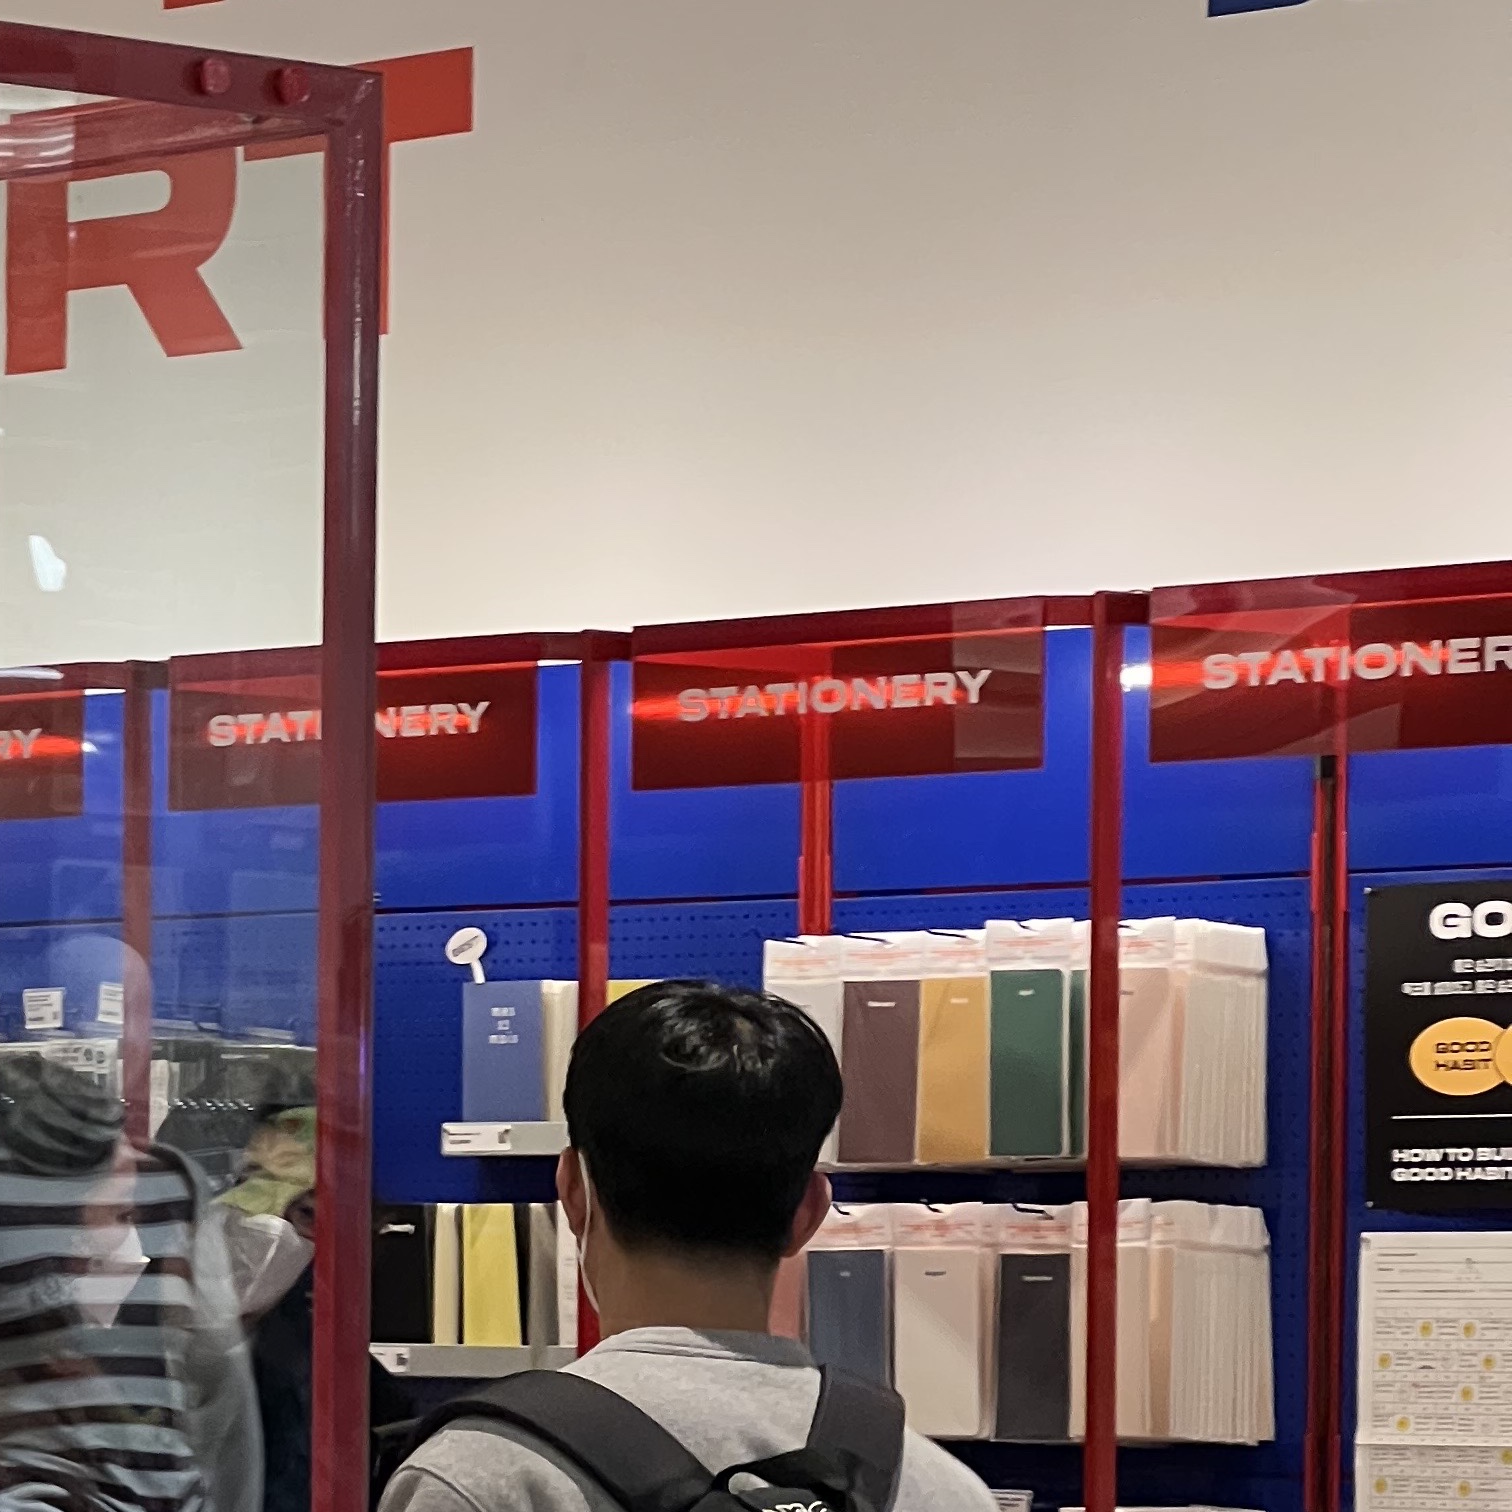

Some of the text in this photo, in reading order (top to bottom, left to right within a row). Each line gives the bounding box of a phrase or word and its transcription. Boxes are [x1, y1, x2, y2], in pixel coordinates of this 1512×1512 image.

[677, 670, 991, 722] STATIONERY
[208, 701, 491, 747] STATINERY
[1436, 1041, 1491, 1054] GOOD
[1434, 1058, 1492, 1071] HABIT
[1391, 1167, 1454, 1182] GOOD
